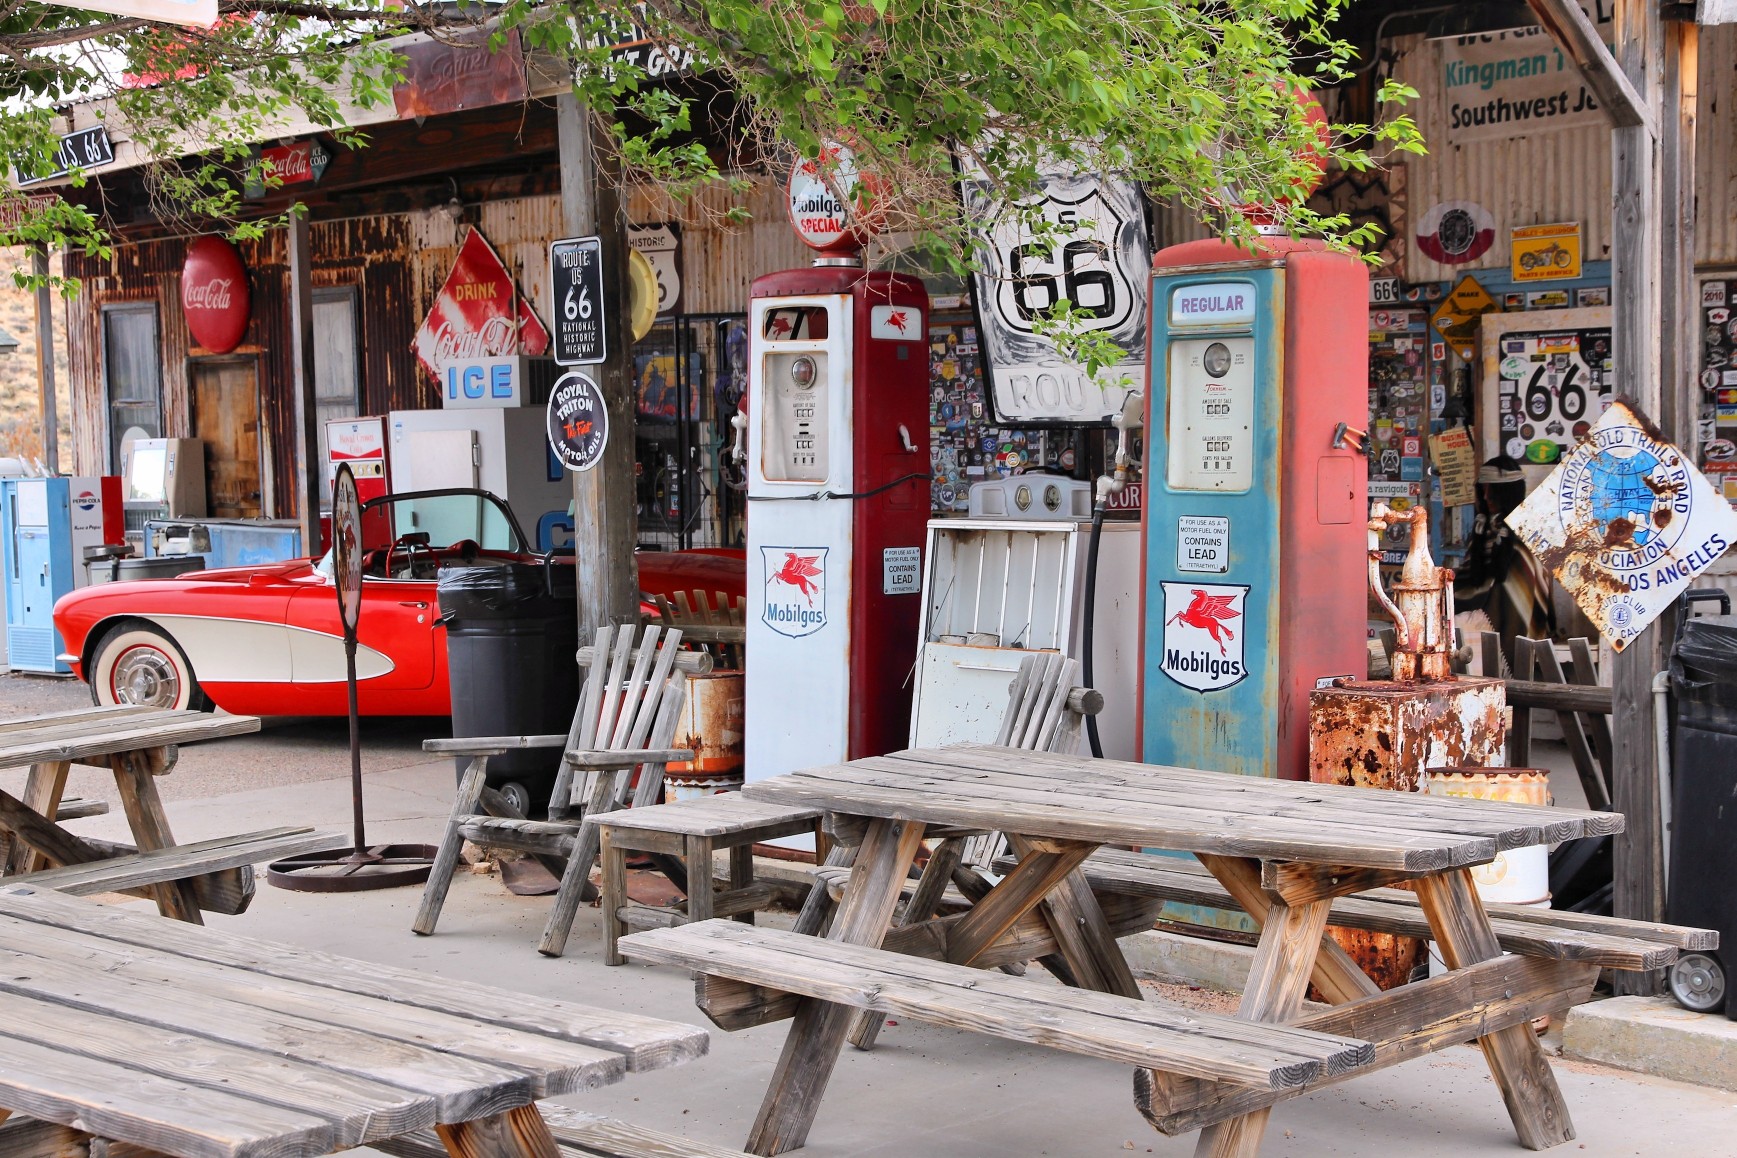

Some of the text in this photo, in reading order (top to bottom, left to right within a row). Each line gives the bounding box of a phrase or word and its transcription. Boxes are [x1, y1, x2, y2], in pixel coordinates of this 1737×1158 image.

[1446, 54, 1547, 90] Kingman
[1452, 91, 1568, 129] Southwest
[84, 132, 101, 163] 66
[311, 147, 321, 156] ICE
[263, 149, 307, 180] Cca-Cola
[310, 155, 327, 167] COLD
[801, 219, 843, 233] SPECIAL
[629, 236, 666, 247] HISTORIC
[563, 250, 589, 268] ROUTE
[571, 269, 582, 284] US
[656, 269, 668, 303] 6
[1010, 239, 1116, 321] 66
[184, 278, 233, 310] Coca-Cola
[455, 281, 497, 301] DRINK
[1374, 282, 1390, 300] 66
[1704, 291, 1724, 301] 2010
[564, 285, 592, 320] 66
[1181, 294, 1244, 314] REGULAR
[563, 320, 597, 332] NATIONAL
[563, 331, 596, 342] HISTORIC
[565, 341, 595, 354] HIGHWAY
[448, 364, 513, 400] ICE
[556, 383, 589, 403] ROYAL
[1525, 363, 1587, 422] 66
[556, 398, 593, 421] TRITON
[558, 429, 602, 461] MOTOR OILS
[1598, 429, 1624, 448] OLD
[1631, 430, 1680, 468] TRAILS
[1375, 484, 1408, 496] ravigote
[1185, 536, 1222, 547] CONTAINS
[1188, 548, 1217, 560] LEAD
[1600, 537, 1669, 568] OCIATION
[1656, 533, 1728, 588] ANGELES
[888, 564, 917, 573] CONTAINS
[892, 574, 913, 585] LEAD
[1623, 594, 1646, 615] CLUB
[767, 603, 823, 628] Mobilgas
[1167, 648, 1240, 681] Mobilgas
